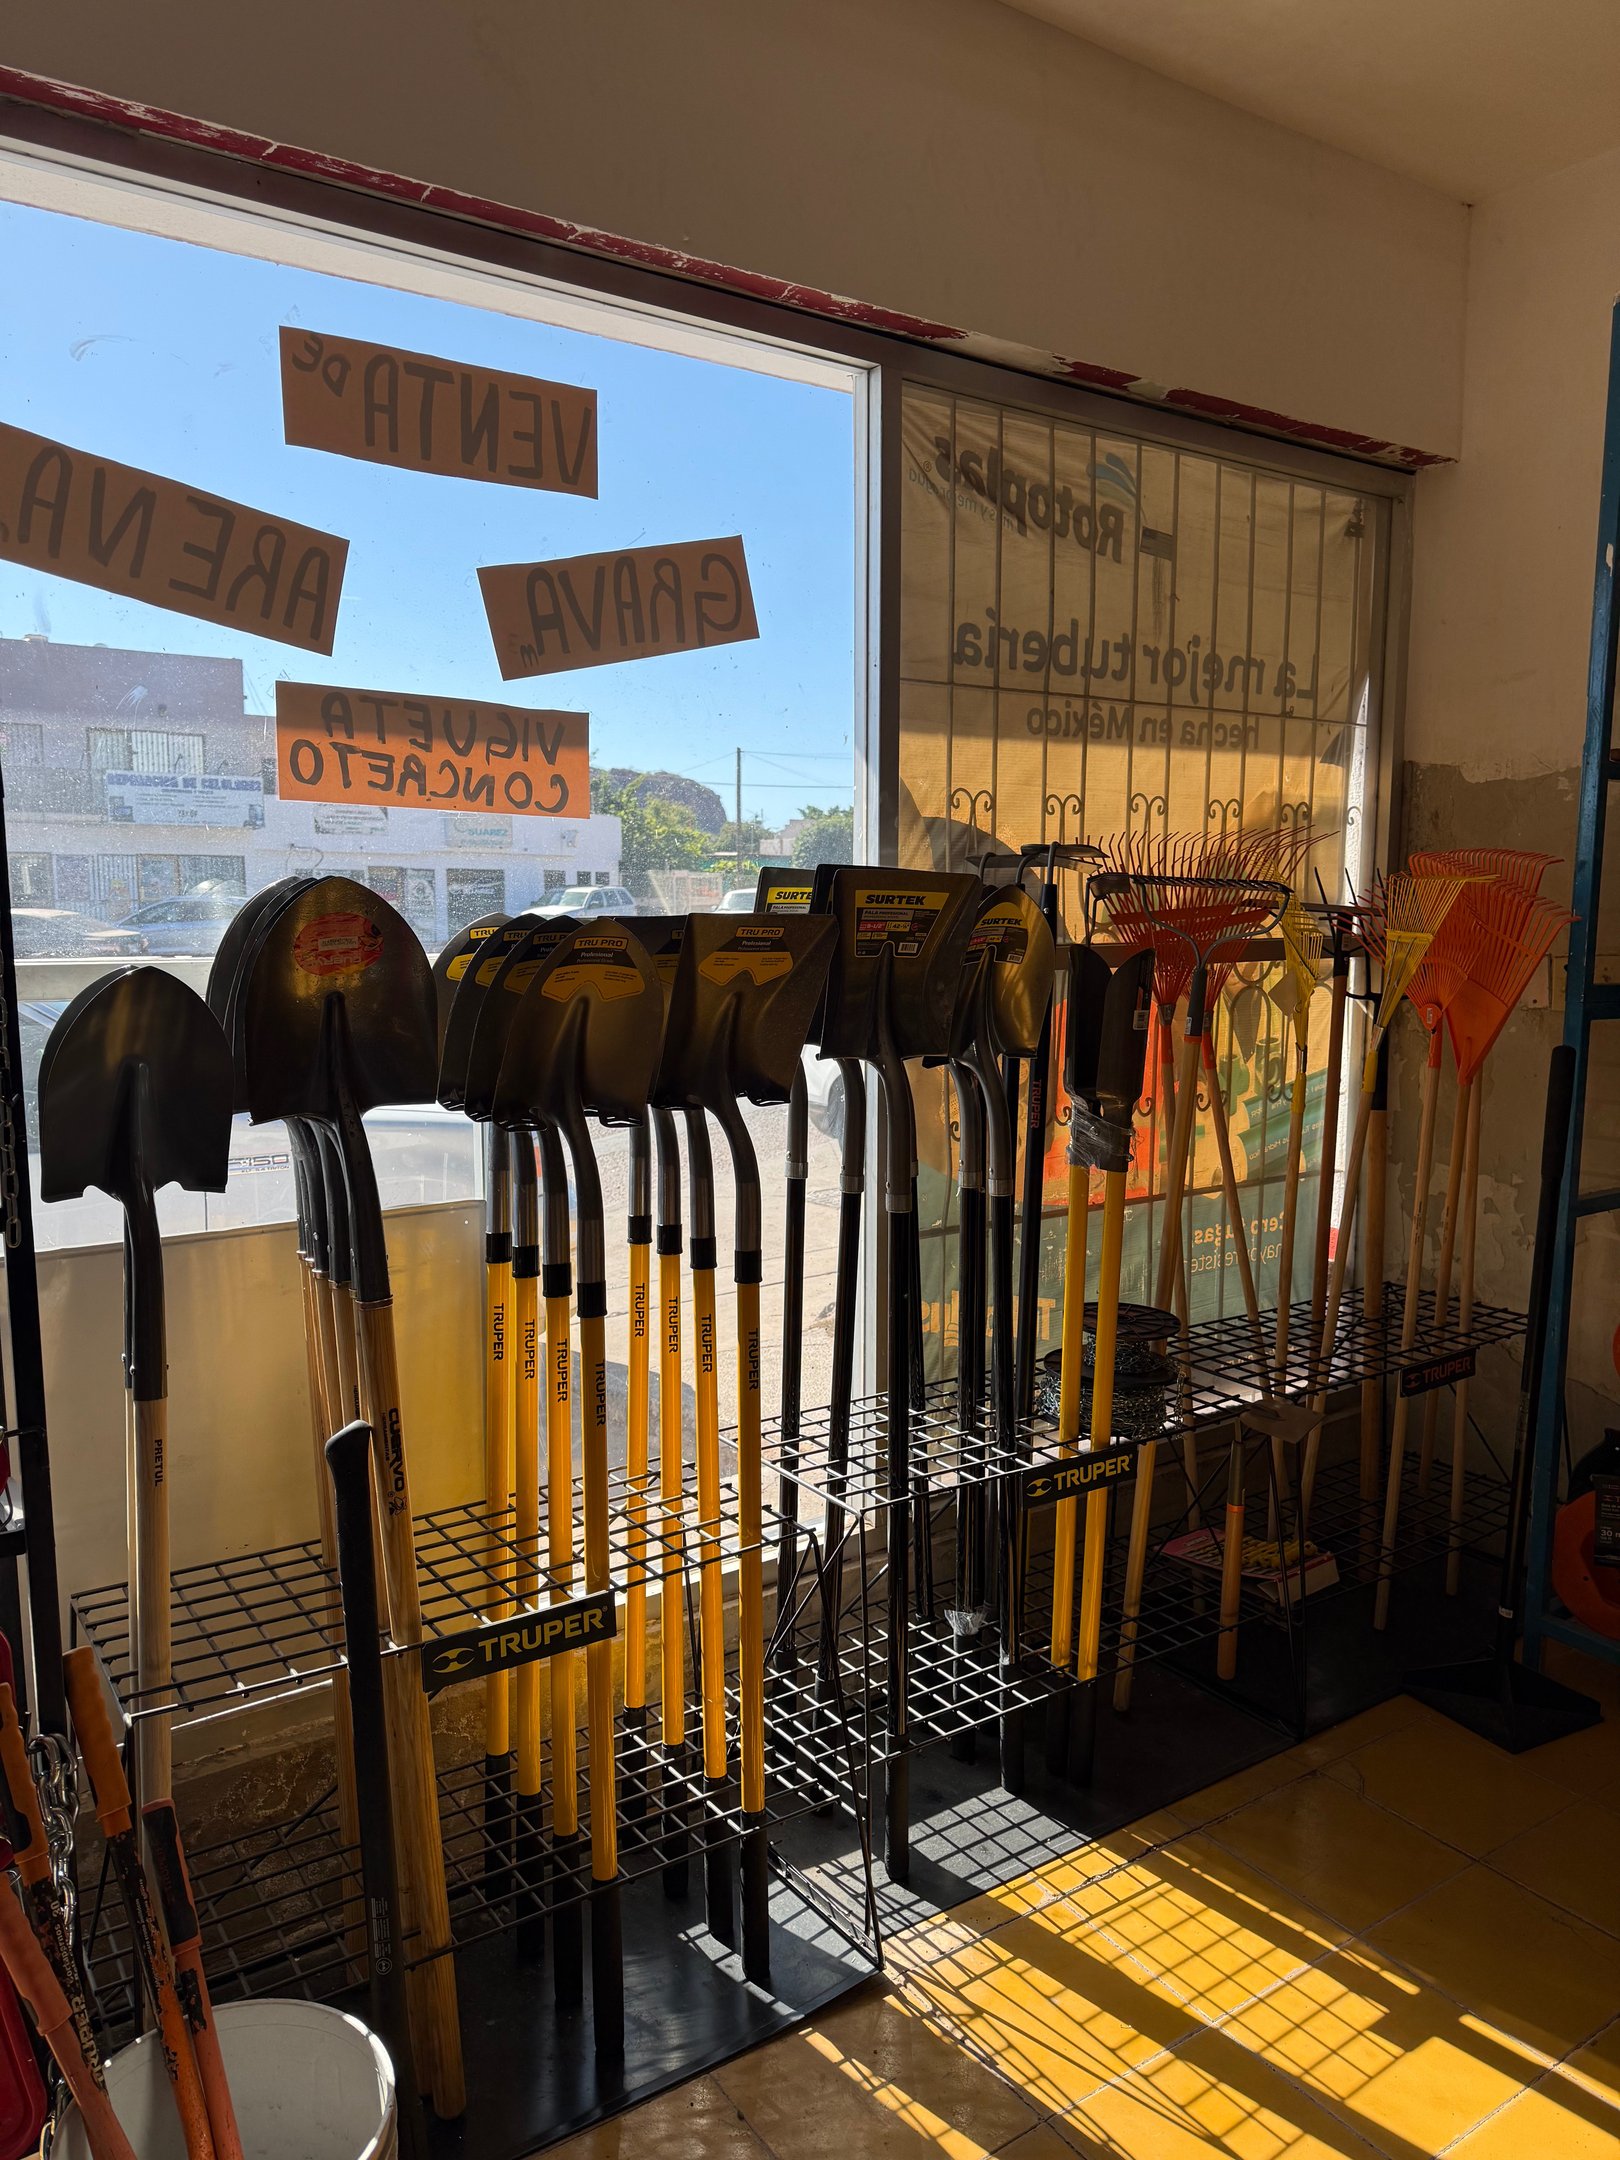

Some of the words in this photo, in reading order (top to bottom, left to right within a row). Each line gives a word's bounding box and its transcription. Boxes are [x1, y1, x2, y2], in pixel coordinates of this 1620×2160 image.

[775, 890, 812, 901] SURTE
[866, 894, 926, 906] SURTEK
[980, 917, 1022, 926] SURTEK
[578, 939, 598, 947] TRU
[600, 939, 623, 947] PRO
[1030, 1079, 1042, 1130] TRUPER
[493, 1302, 504, 1361] TRUPER
[634, 1282, 645, 1338] TRUPER
[667, 1296, 678, 1353] TRUPER
[524, 1318, 535, 1380] TRUPER
[556, 1338, 568, 1403] TRUPER
[701, 1313, 713, 1374] TRUPER
[748, 1327, 759, 1391] TRUPER
[1422, 1356, 1472, 1384] TRUPER
[594, 1358, 606, 1427] TRUPER
[154, 1438, 163, 1487] PRETUL
[389, 1407, 406, 1493] CUERVO
[1054, 1454, 1131, 1491] TRUPER
[478, 1607, 605, 1663] TRUPER
[70, 1992, 105, 2087] TRUPER
